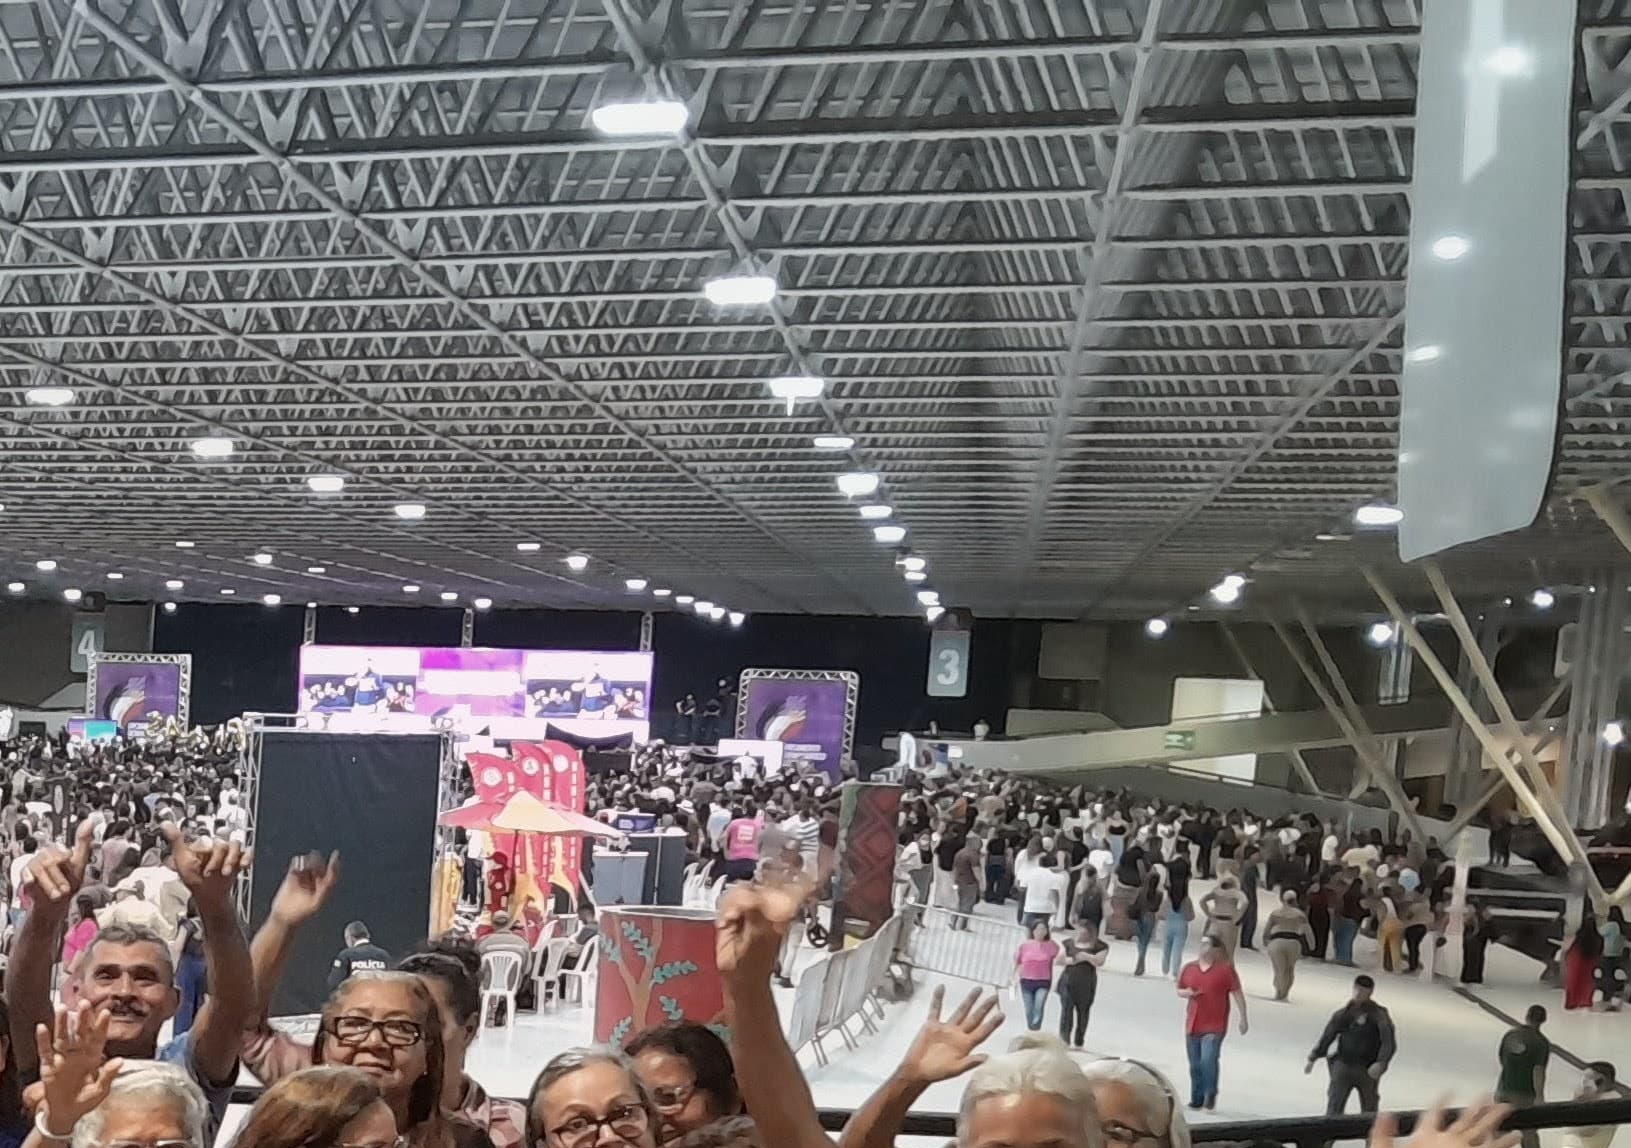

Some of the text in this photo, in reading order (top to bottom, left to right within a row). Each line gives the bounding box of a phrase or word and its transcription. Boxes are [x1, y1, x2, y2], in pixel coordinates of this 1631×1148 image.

[78, 629, 96, 657] 4
[937, 648, 960, 686] 3
[351, 958, 386, 970] POLÍCIA
